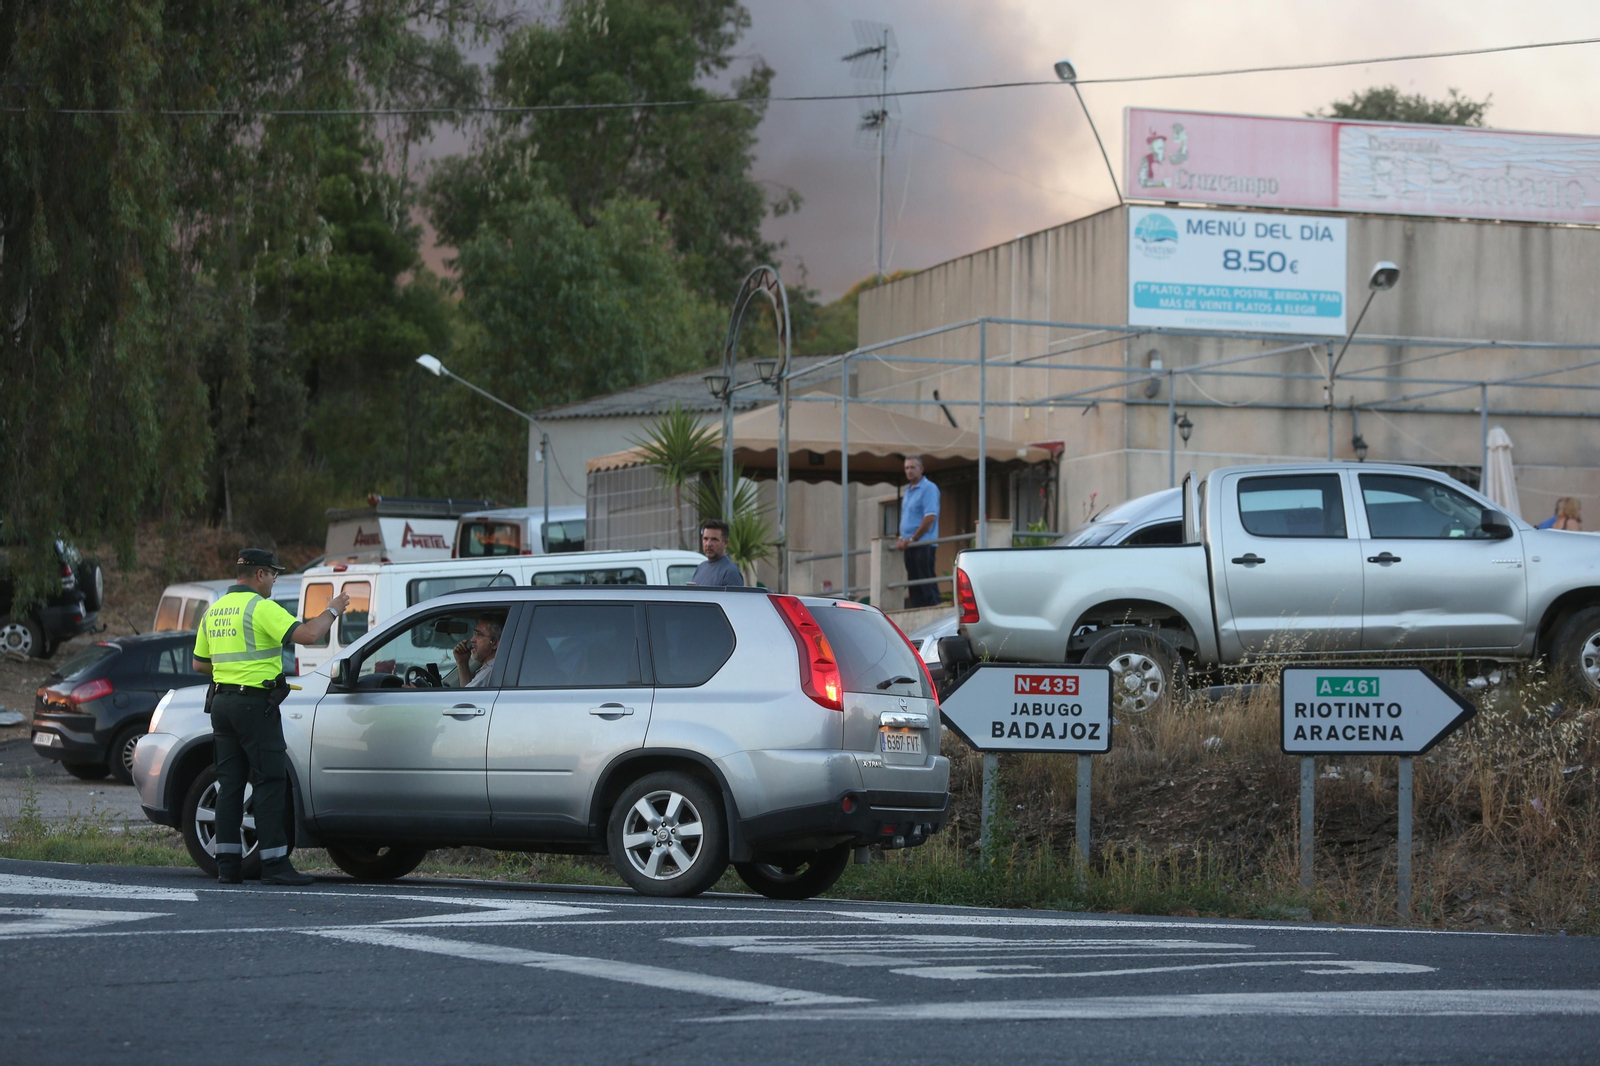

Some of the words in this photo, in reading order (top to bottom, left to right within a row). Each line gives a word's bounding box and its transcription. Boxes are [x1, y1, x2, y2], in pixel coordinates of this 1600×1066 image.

[1175, 168, 1279, 197] Cruzcampo
[1186, 217, 1246, 237] MENÚ
[1255, 222, 1292, 240] DEL
[1300, 220, 1334, 242] DÍA
[1150, 284, 1184, 296] PLATO,
[1197, 287, 1231, 298] PLATO,
[1233, 288, 1272, 300] POSTRE,
[1274, 291, 1309, 301] BEBIDA
[1310, 292, 1318, 301] Y
[1319, 293, 1340, 303] PAN
[1159, 296, 1181, 308] MÁS
[1184, 299, 1197, 309] DE
[1199, 300, 1233, 311] VEINTE
[1235, 302, 1272, 313] PLATOS
[1275, 304, 1282, 313] A
[1284, 304, 1317, 315] ELEGIR
[401, 521, 450, 549] AMETEL
[210, 607, 240, 617] GUARDIA
[214, 618, 231, 627] CIVIL
[209, 628, 237, 638] TRAFICO
[1017, 677, 1076, 693] N-435
[1319, 679, 1377, 694] A-461
[1010, 702, 1083, 716] JABUGO
[1294, 702, 1403, 718] RIOTINTO
[991, 721, 1101, 740] BADAJOZ
[1293, 725, 1404, 741] ARACENA
